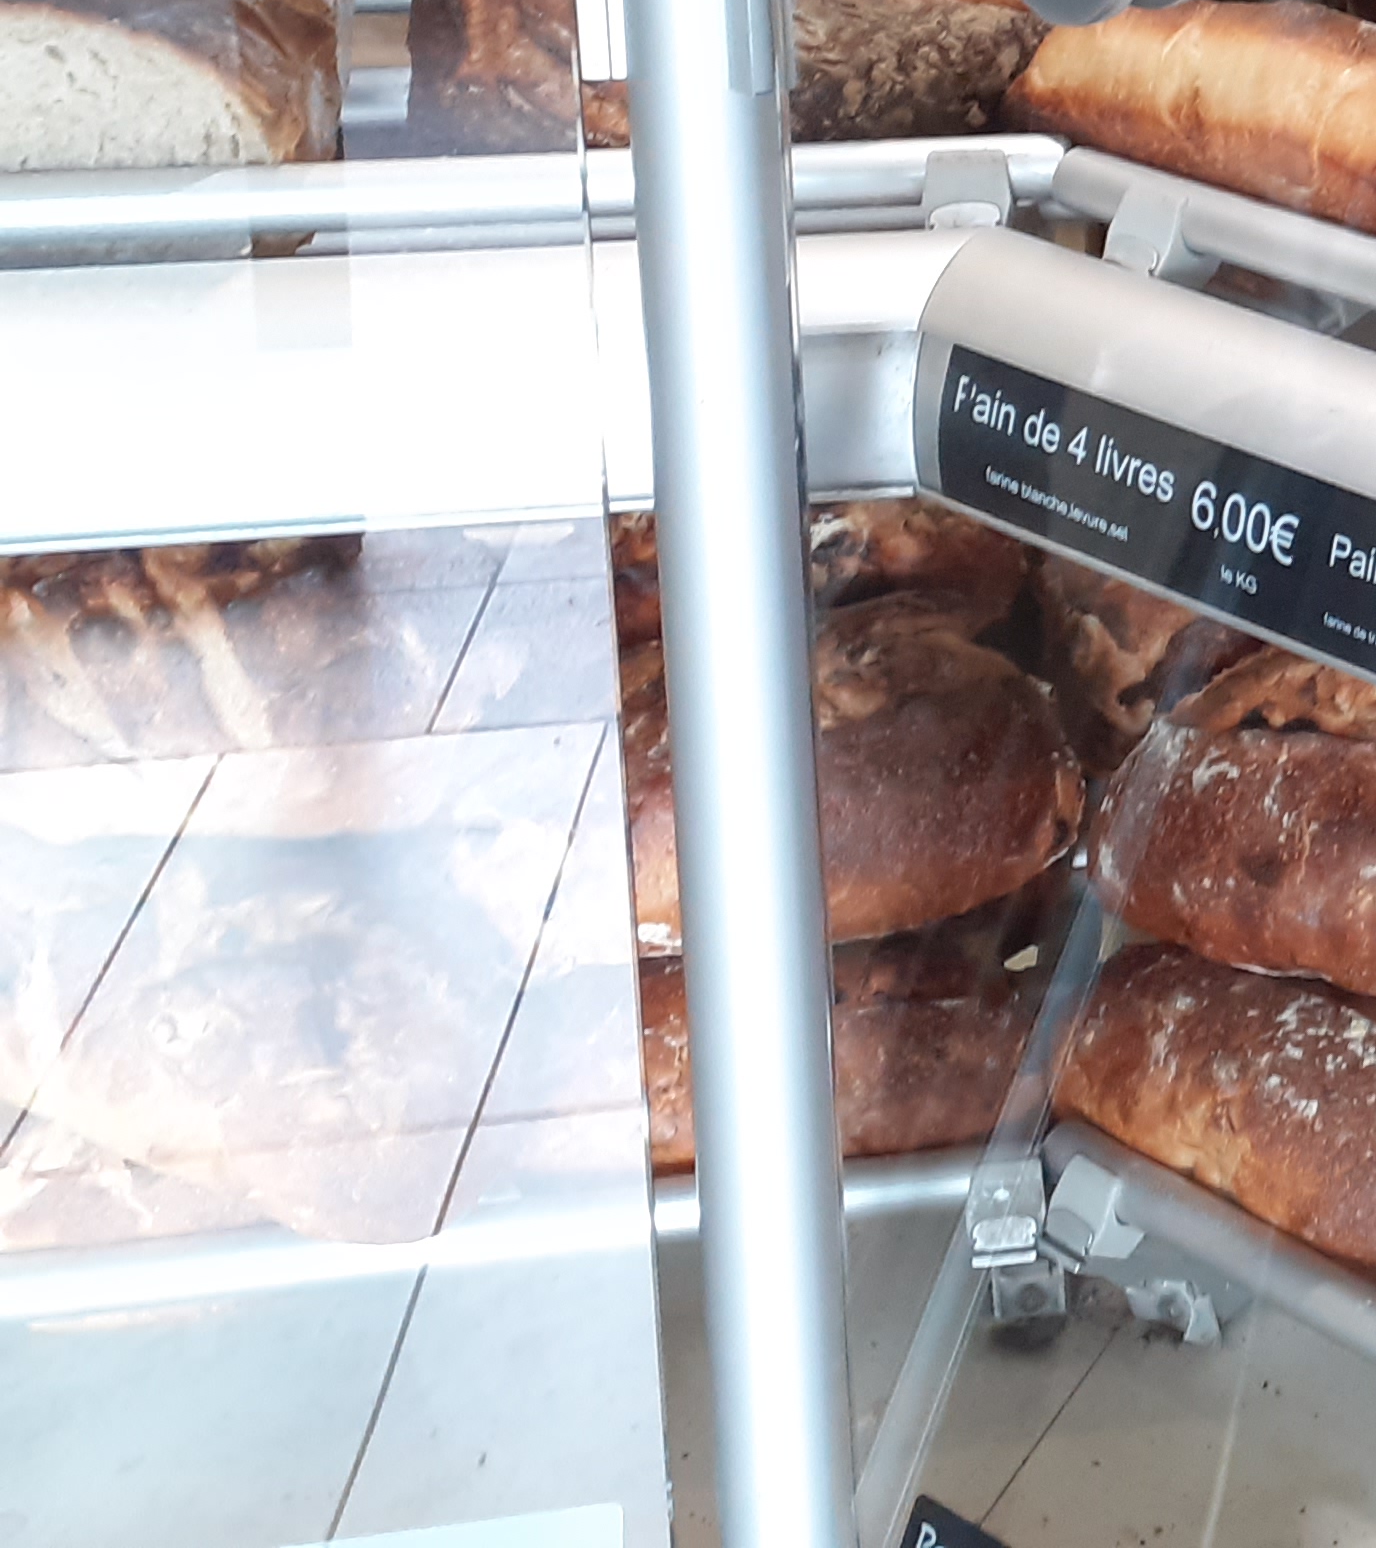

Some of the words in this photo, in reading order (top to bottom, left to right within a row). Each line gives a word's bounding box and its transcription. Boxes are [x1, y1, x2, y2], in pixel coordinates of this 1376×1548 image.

[1023, 408, 1060, 454] de
[1067, 426, 1088, 466] 4
[1095, 433, 1175, 503] livres
[1191, 480, 1299, 567] 6,00€
[1220, 564, 1233, 584] le
[1235, 570, 1257, 595] KG
